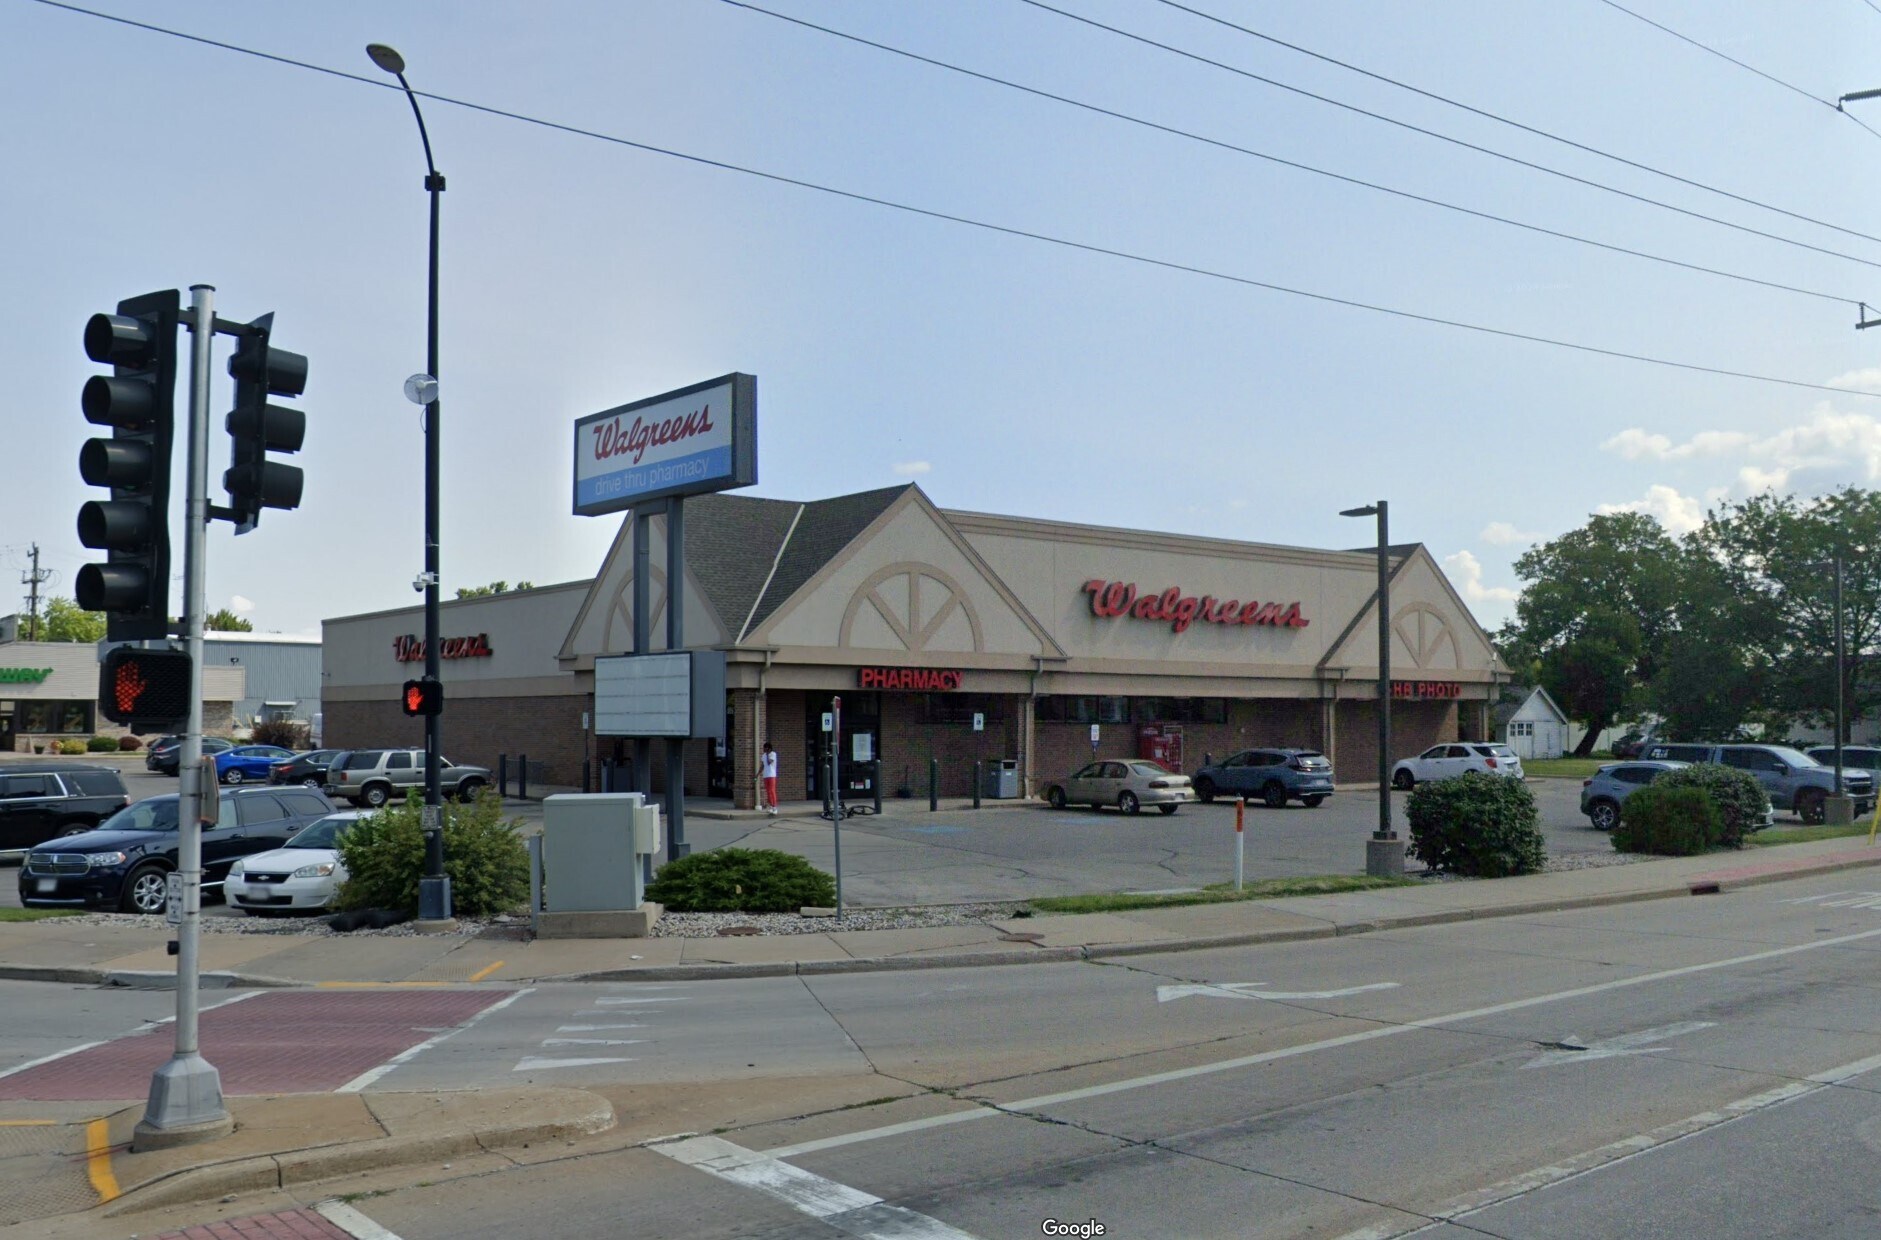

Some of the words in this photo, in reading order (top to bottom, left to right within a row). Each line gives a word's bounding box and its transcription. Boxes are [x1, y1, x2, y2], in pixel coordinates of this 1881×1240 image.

[593, 404, 714, 465] Walgreens
[595, 478, 622, 496] drive
[624, 471, 647, 489] thru
[651, 455, 710, 488] pharmacy
[1083, 579, 1310, 634] Walgreens
[861, 668, 964, 690] PHARMACY
[1418, 682, 1463, 698] PHOTO
